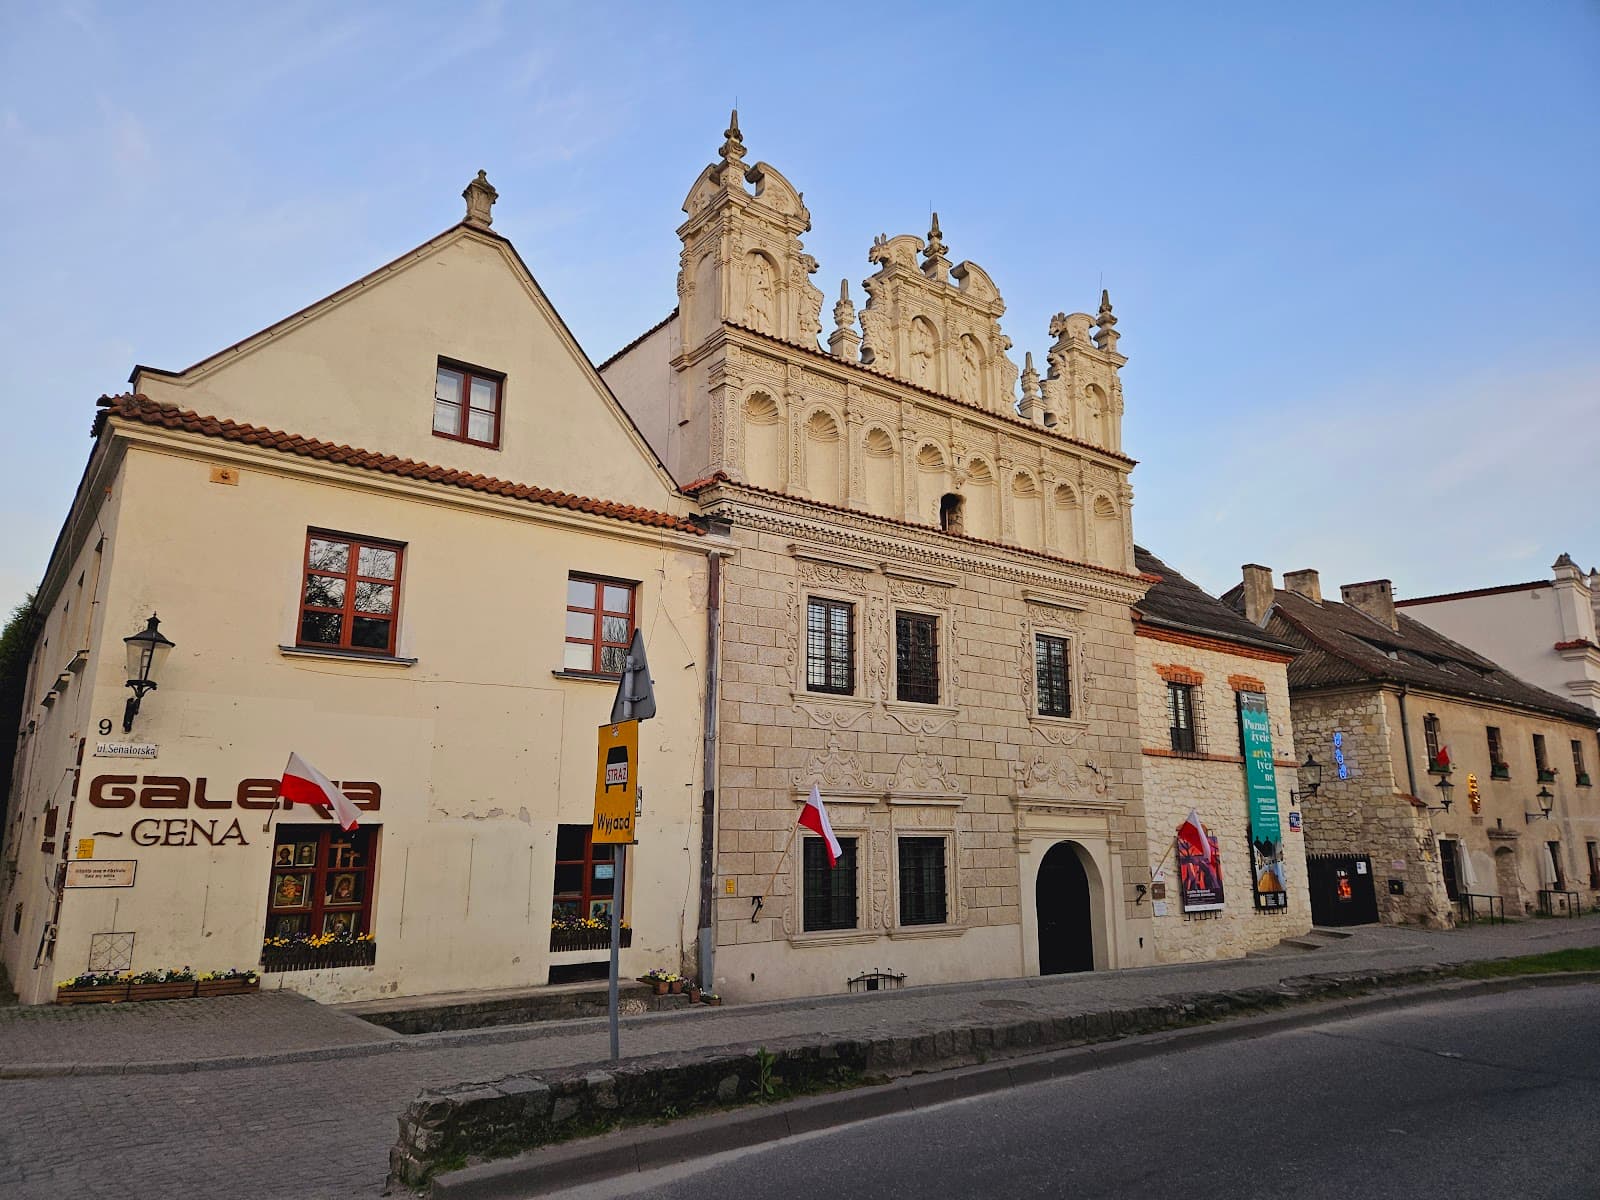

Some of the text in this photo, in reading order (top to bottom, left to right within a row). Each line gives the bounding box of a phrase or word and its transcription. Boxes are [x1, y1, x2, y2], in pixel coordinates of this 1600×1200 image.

[98, 718, 113, 736] 9
[130, 817, 250, 847] GENA
[597, 811, 631, 836] Wyjazd
